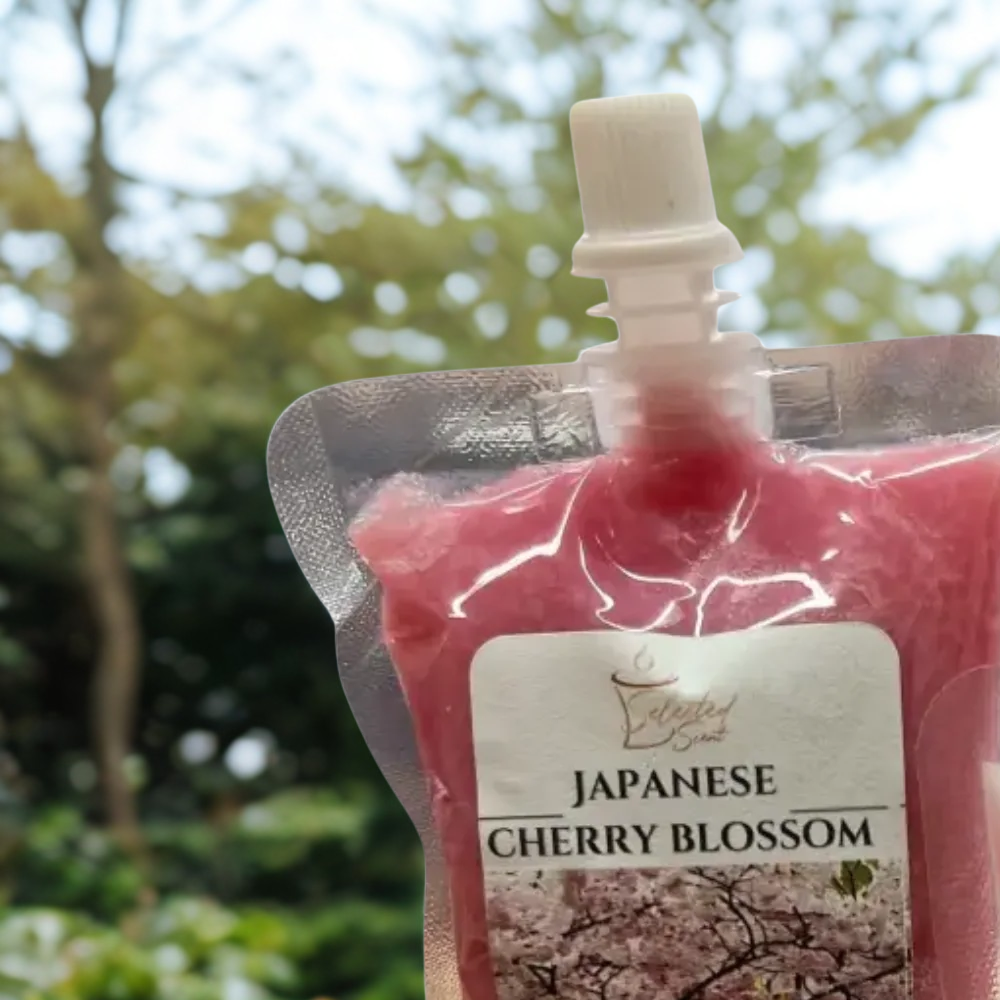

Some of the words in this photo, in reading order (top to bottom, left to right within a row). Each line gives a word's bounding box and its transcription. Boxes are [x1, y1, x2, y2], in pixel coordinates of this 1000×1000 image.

[572, 764, 777, 808] JAPANESE
[487, 824, 660, 858] CHERRY
[672, 817, 874, 856] BLOSSOM
